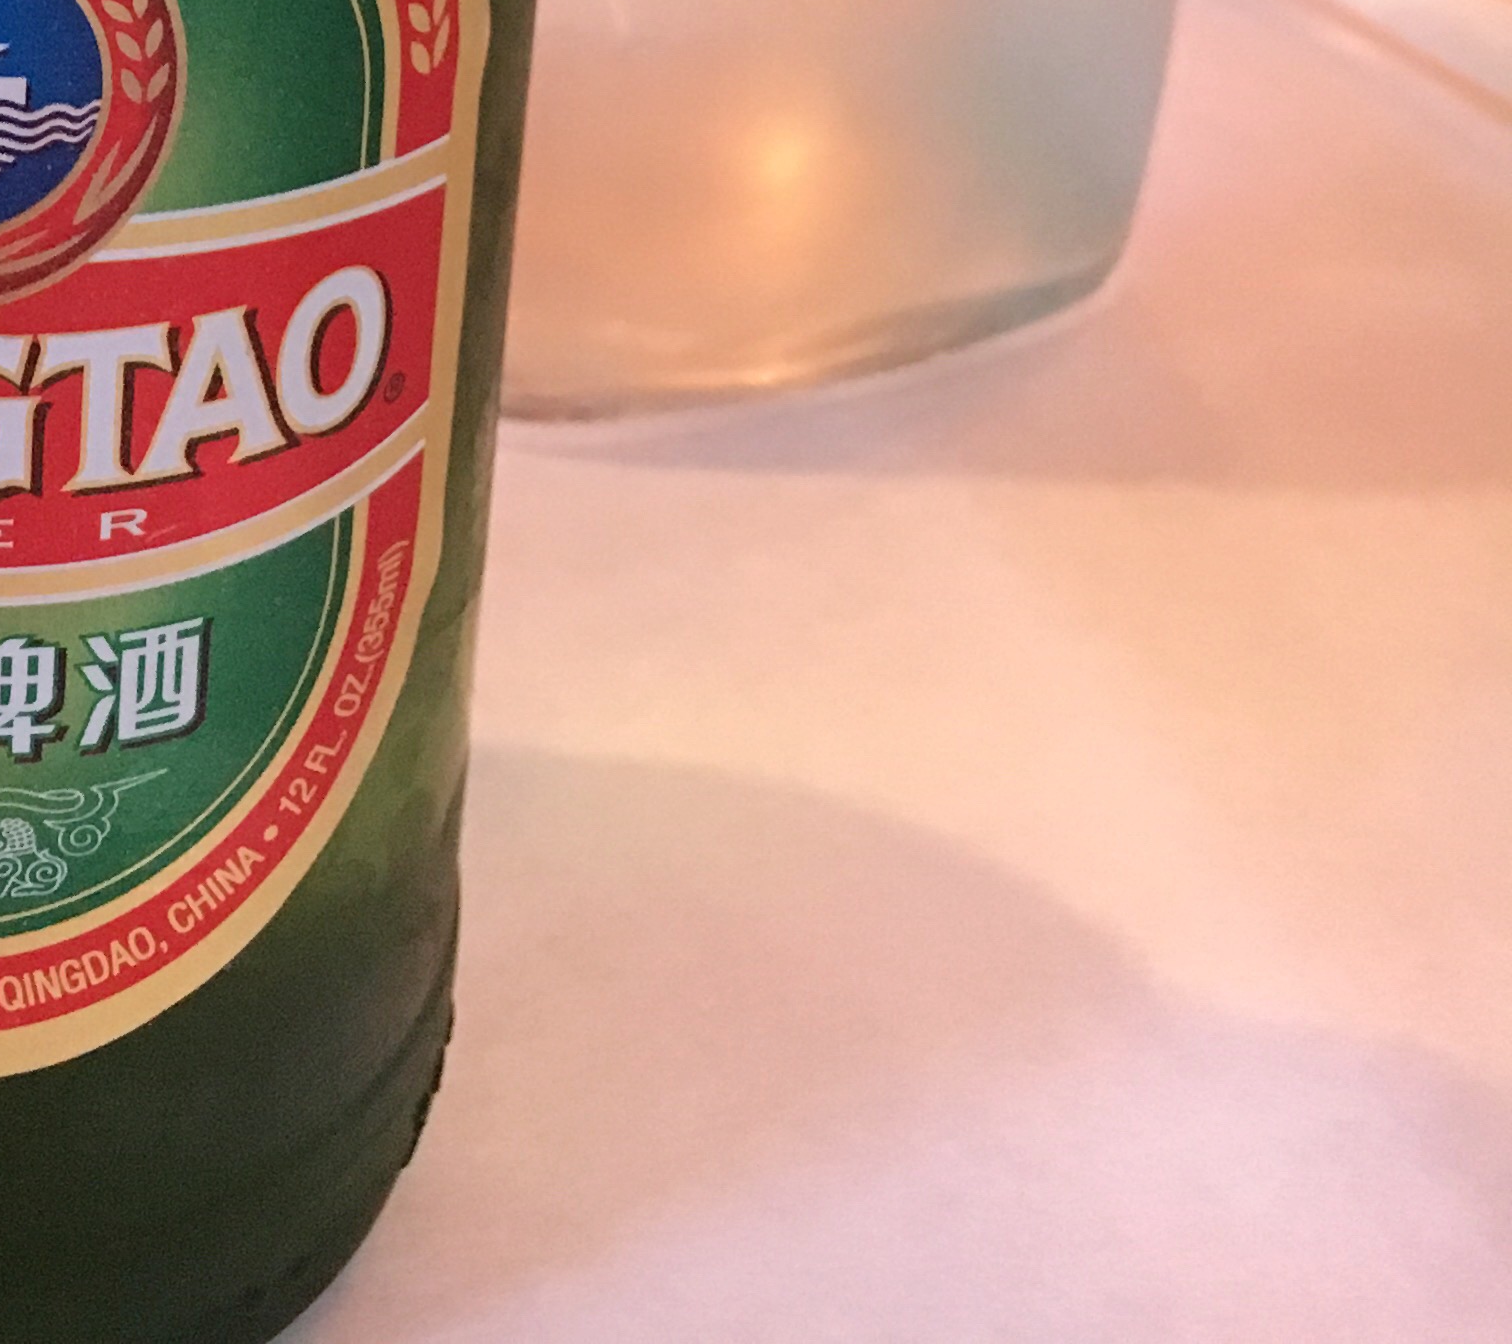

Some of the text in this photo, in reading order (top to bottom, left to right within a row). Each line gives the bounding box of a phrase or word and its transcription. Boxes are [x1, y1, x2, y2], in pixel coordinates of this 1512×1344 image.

[166, 845, 266, 935] CHINA
[278, 776, 319, 815] 12
[303, 729, 349, 774] FL.
